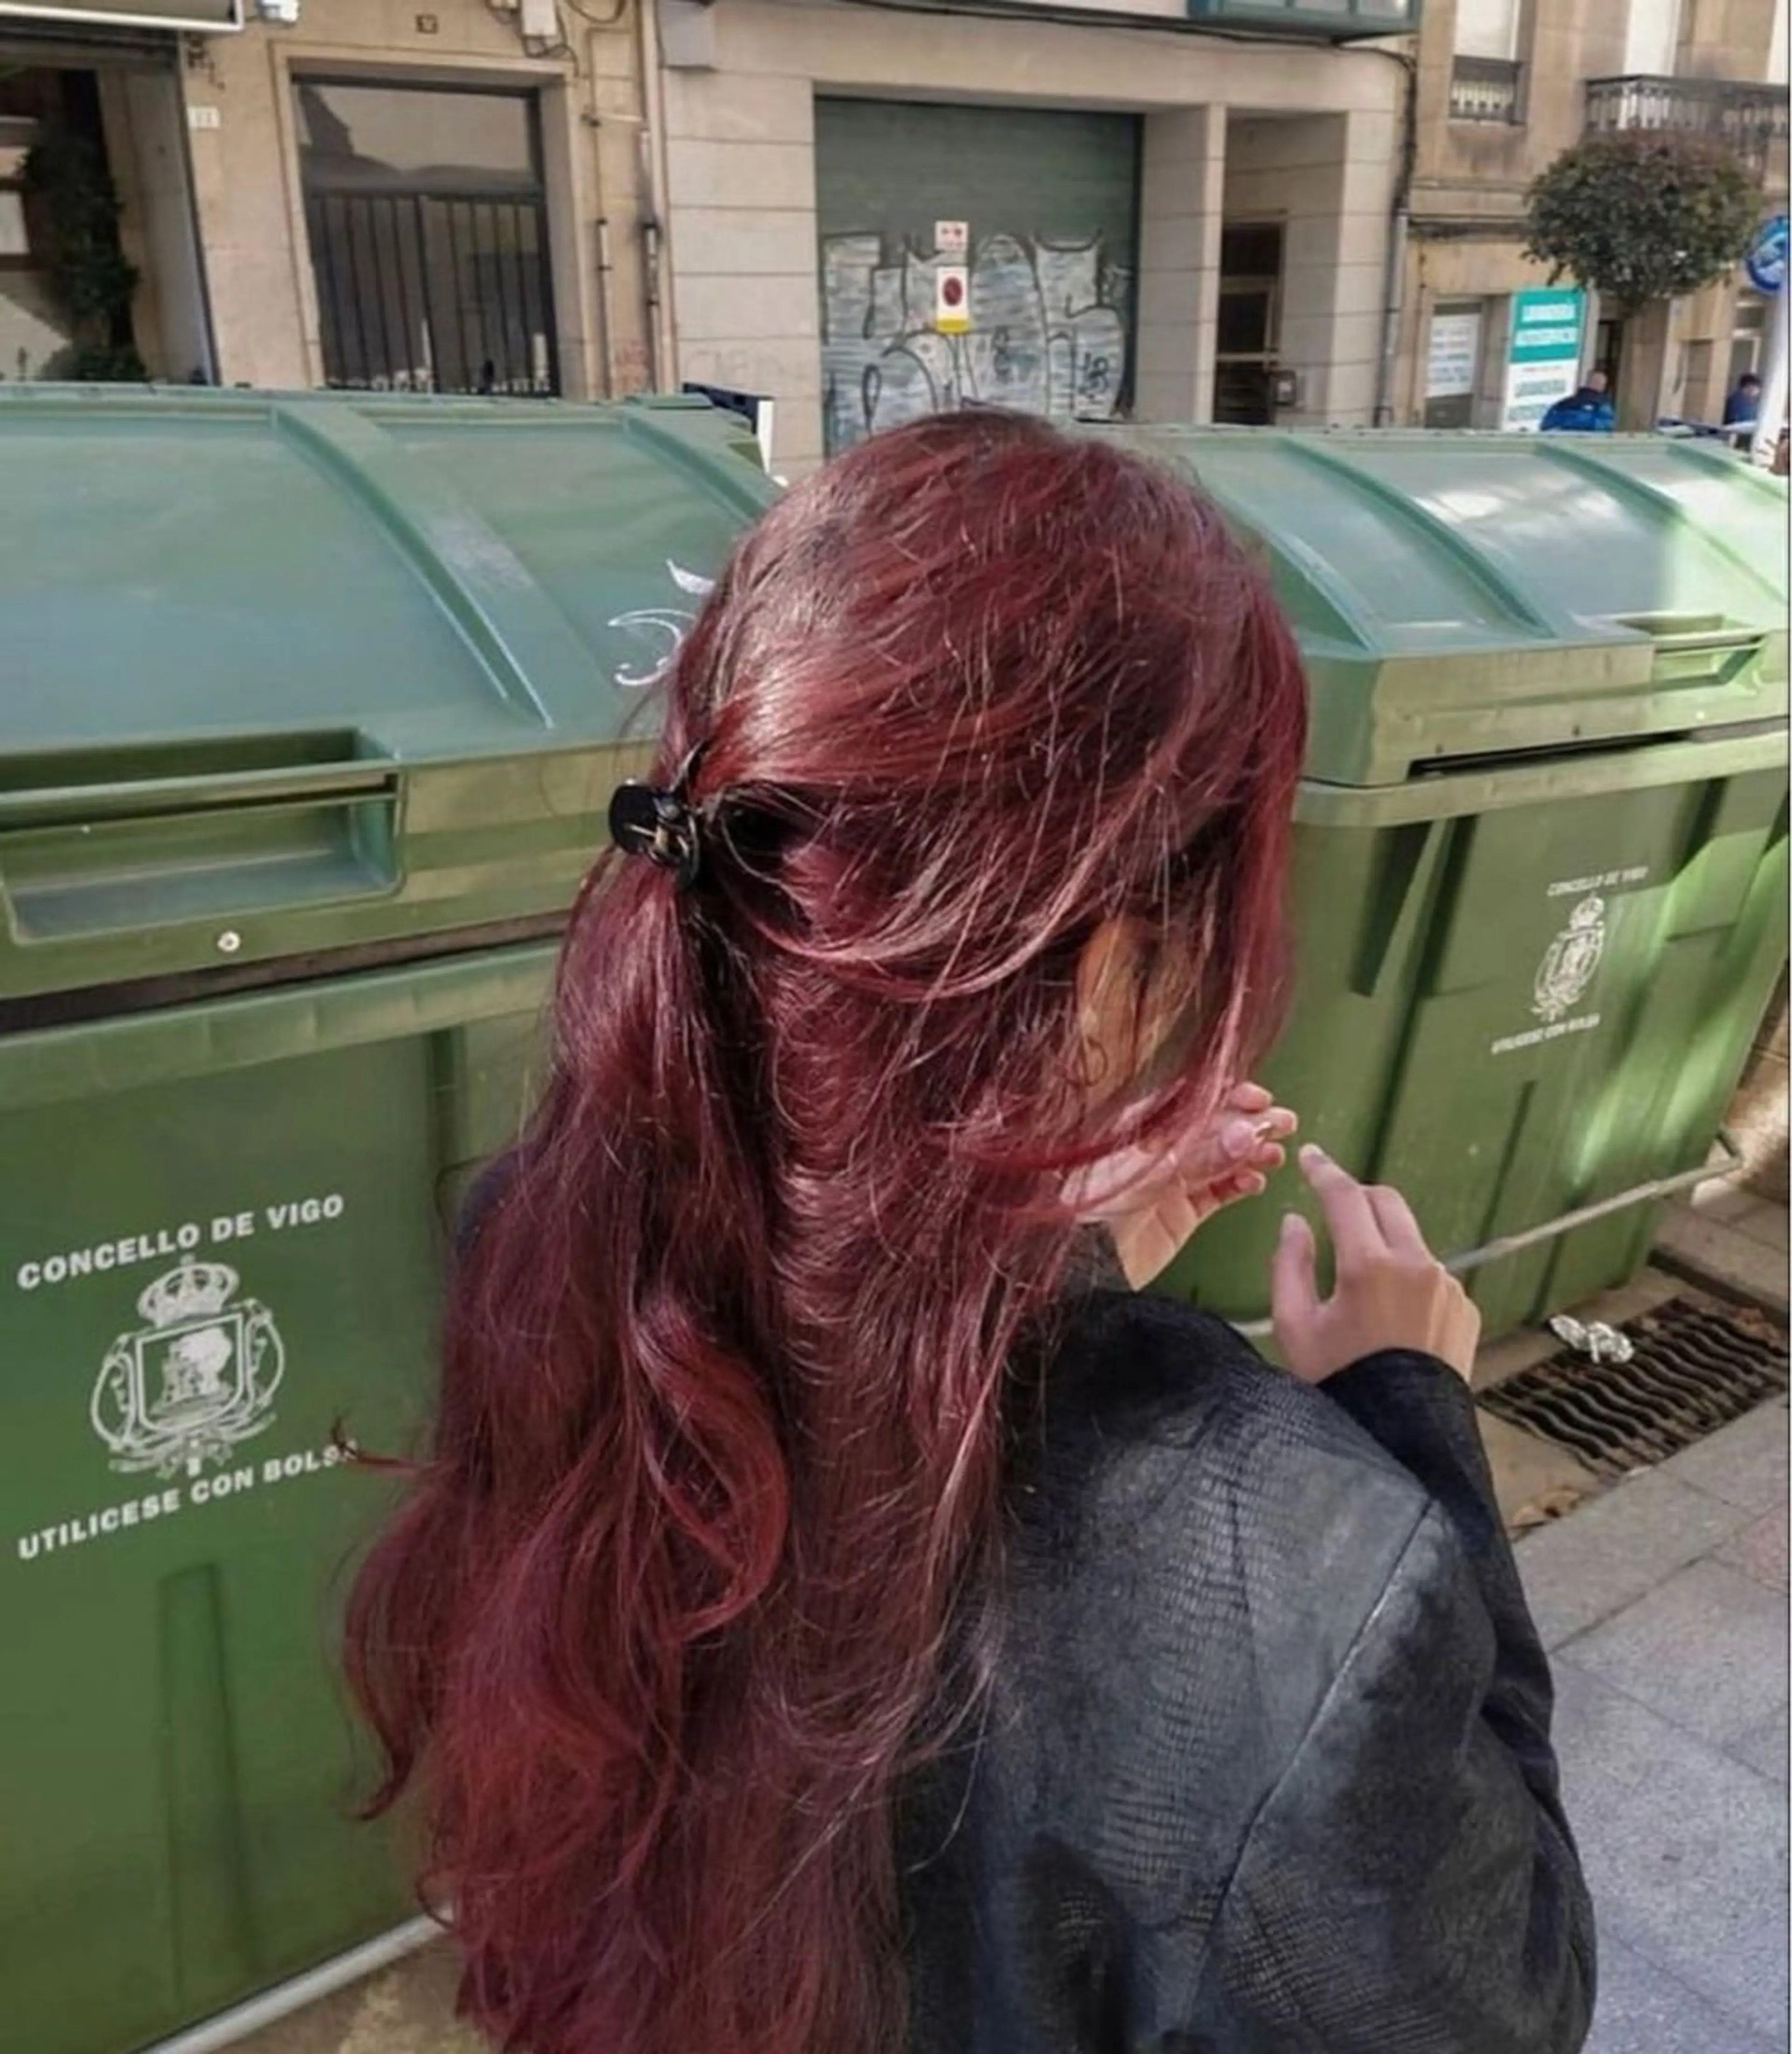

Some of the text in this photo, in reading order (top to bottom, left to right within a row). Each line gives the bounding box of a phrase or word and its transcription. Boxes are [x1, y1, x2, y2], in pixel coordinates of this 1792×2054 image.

[17, 1193, 344, 1291] CONCELLO DE VIGO
[18, 1488, 181, 1559] UTILICESE
[190, 1466, 255, 1504] CON
